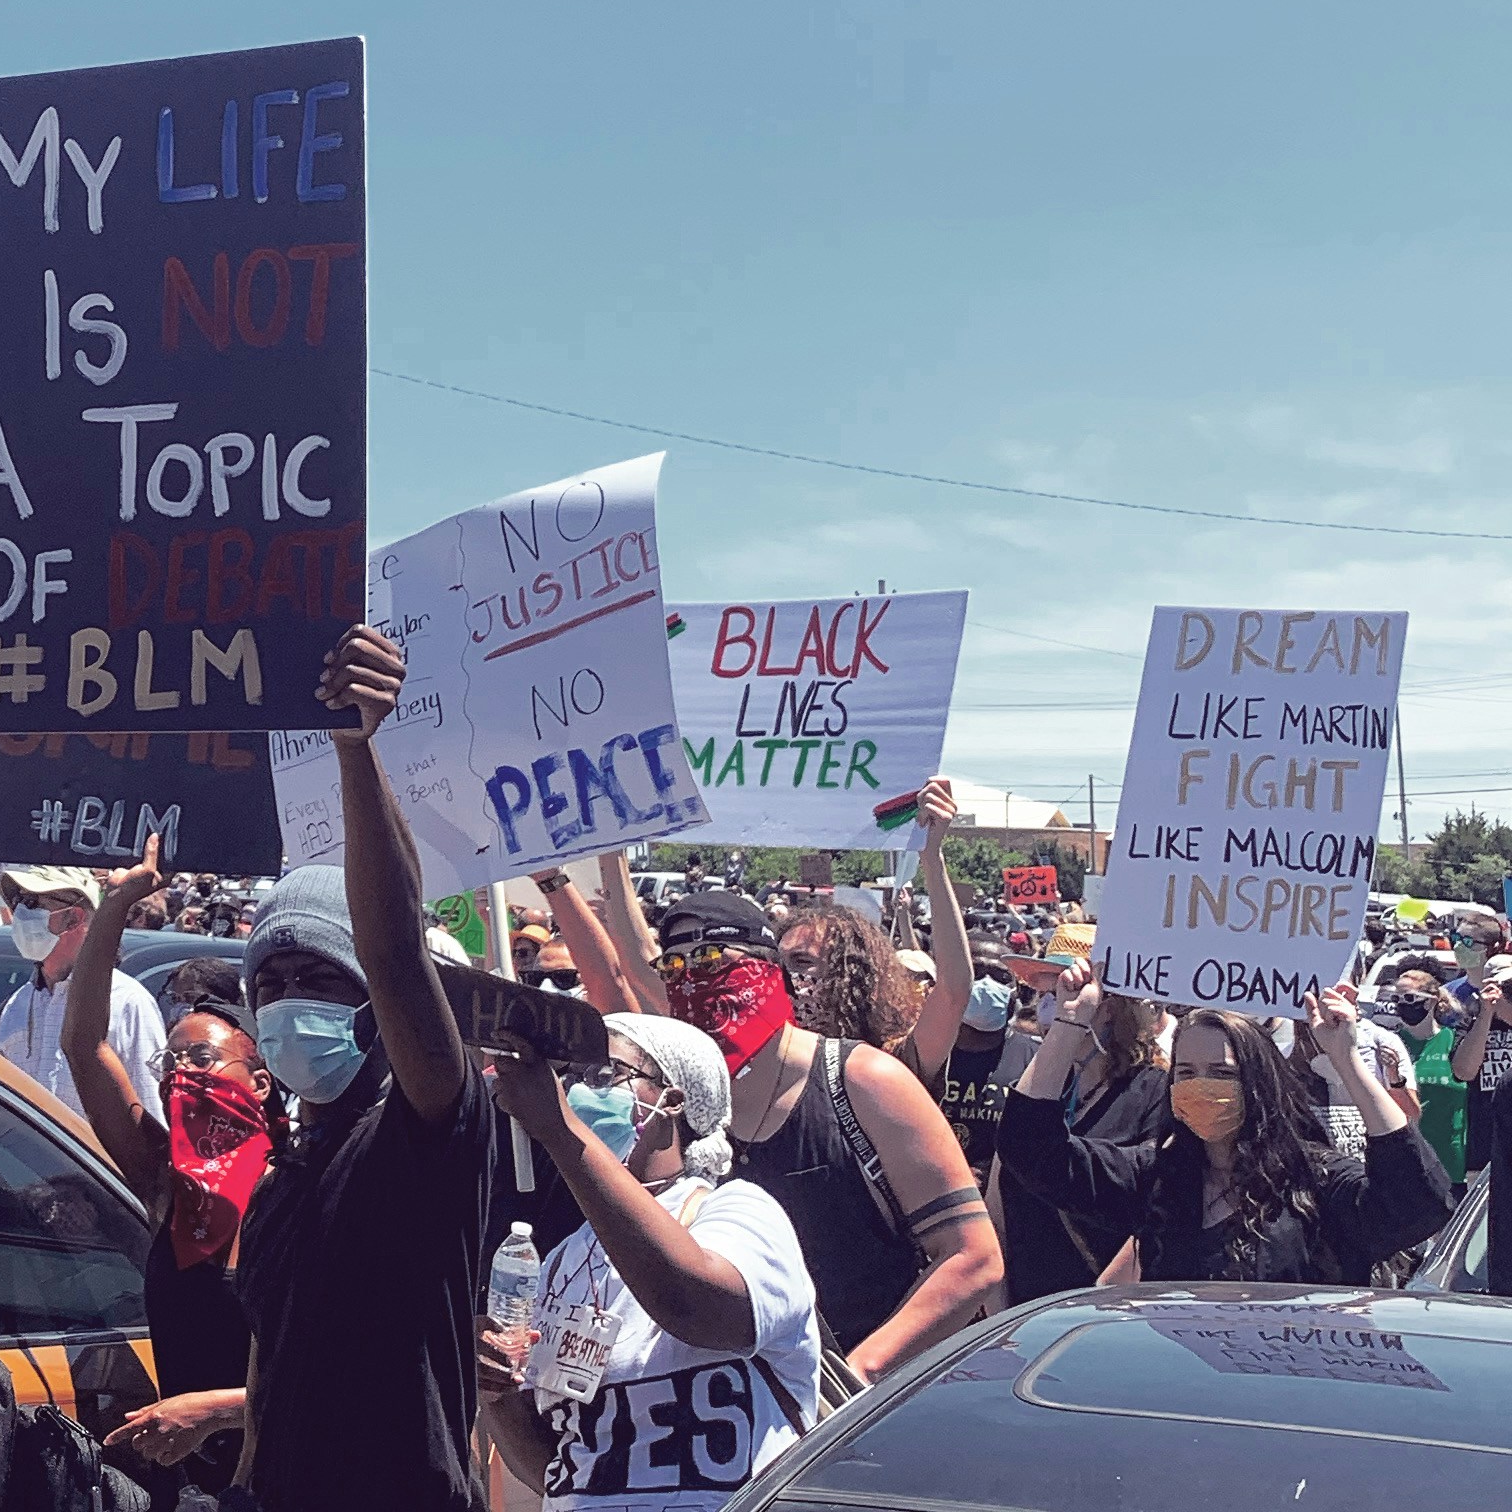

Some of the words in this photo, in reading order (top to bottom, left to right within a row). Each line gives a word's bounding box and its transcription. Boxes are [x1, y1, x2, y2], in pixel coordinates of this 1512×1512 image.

[156, 80, 350, 204] LIFE
[160, 242, 361, 355] NOT
[499, 480, 605, 574] NO
[108, 519, 367, 631] DEBATE
[710, 598, 892, 679] BLACK
[1175, 610, 1391, 676] DREAM
[532, 667, 605, 741] NO
[735, 679, 854, 739] LIVES
[1168, 692, 1266, 741] LIKE
[1279, 701, 1389, 750] MARTIN
[271, 728, 334, 765] Ahma
[406, 753, 437, 777] that
[682, 736, 881, 791] MATTER
[1177, 748, 1361, 813] FIGHT
[29, 795, 182, 863] #BLM
[297, 820, 333, 855] HAD
[1128, 823, 1204, 862] LIKE
[1223, 826, 1376, 884] MALCOLM
[1161, 873, 1355, 941] INSPIRE
[1101, 946, 1173, 997] LIKE
